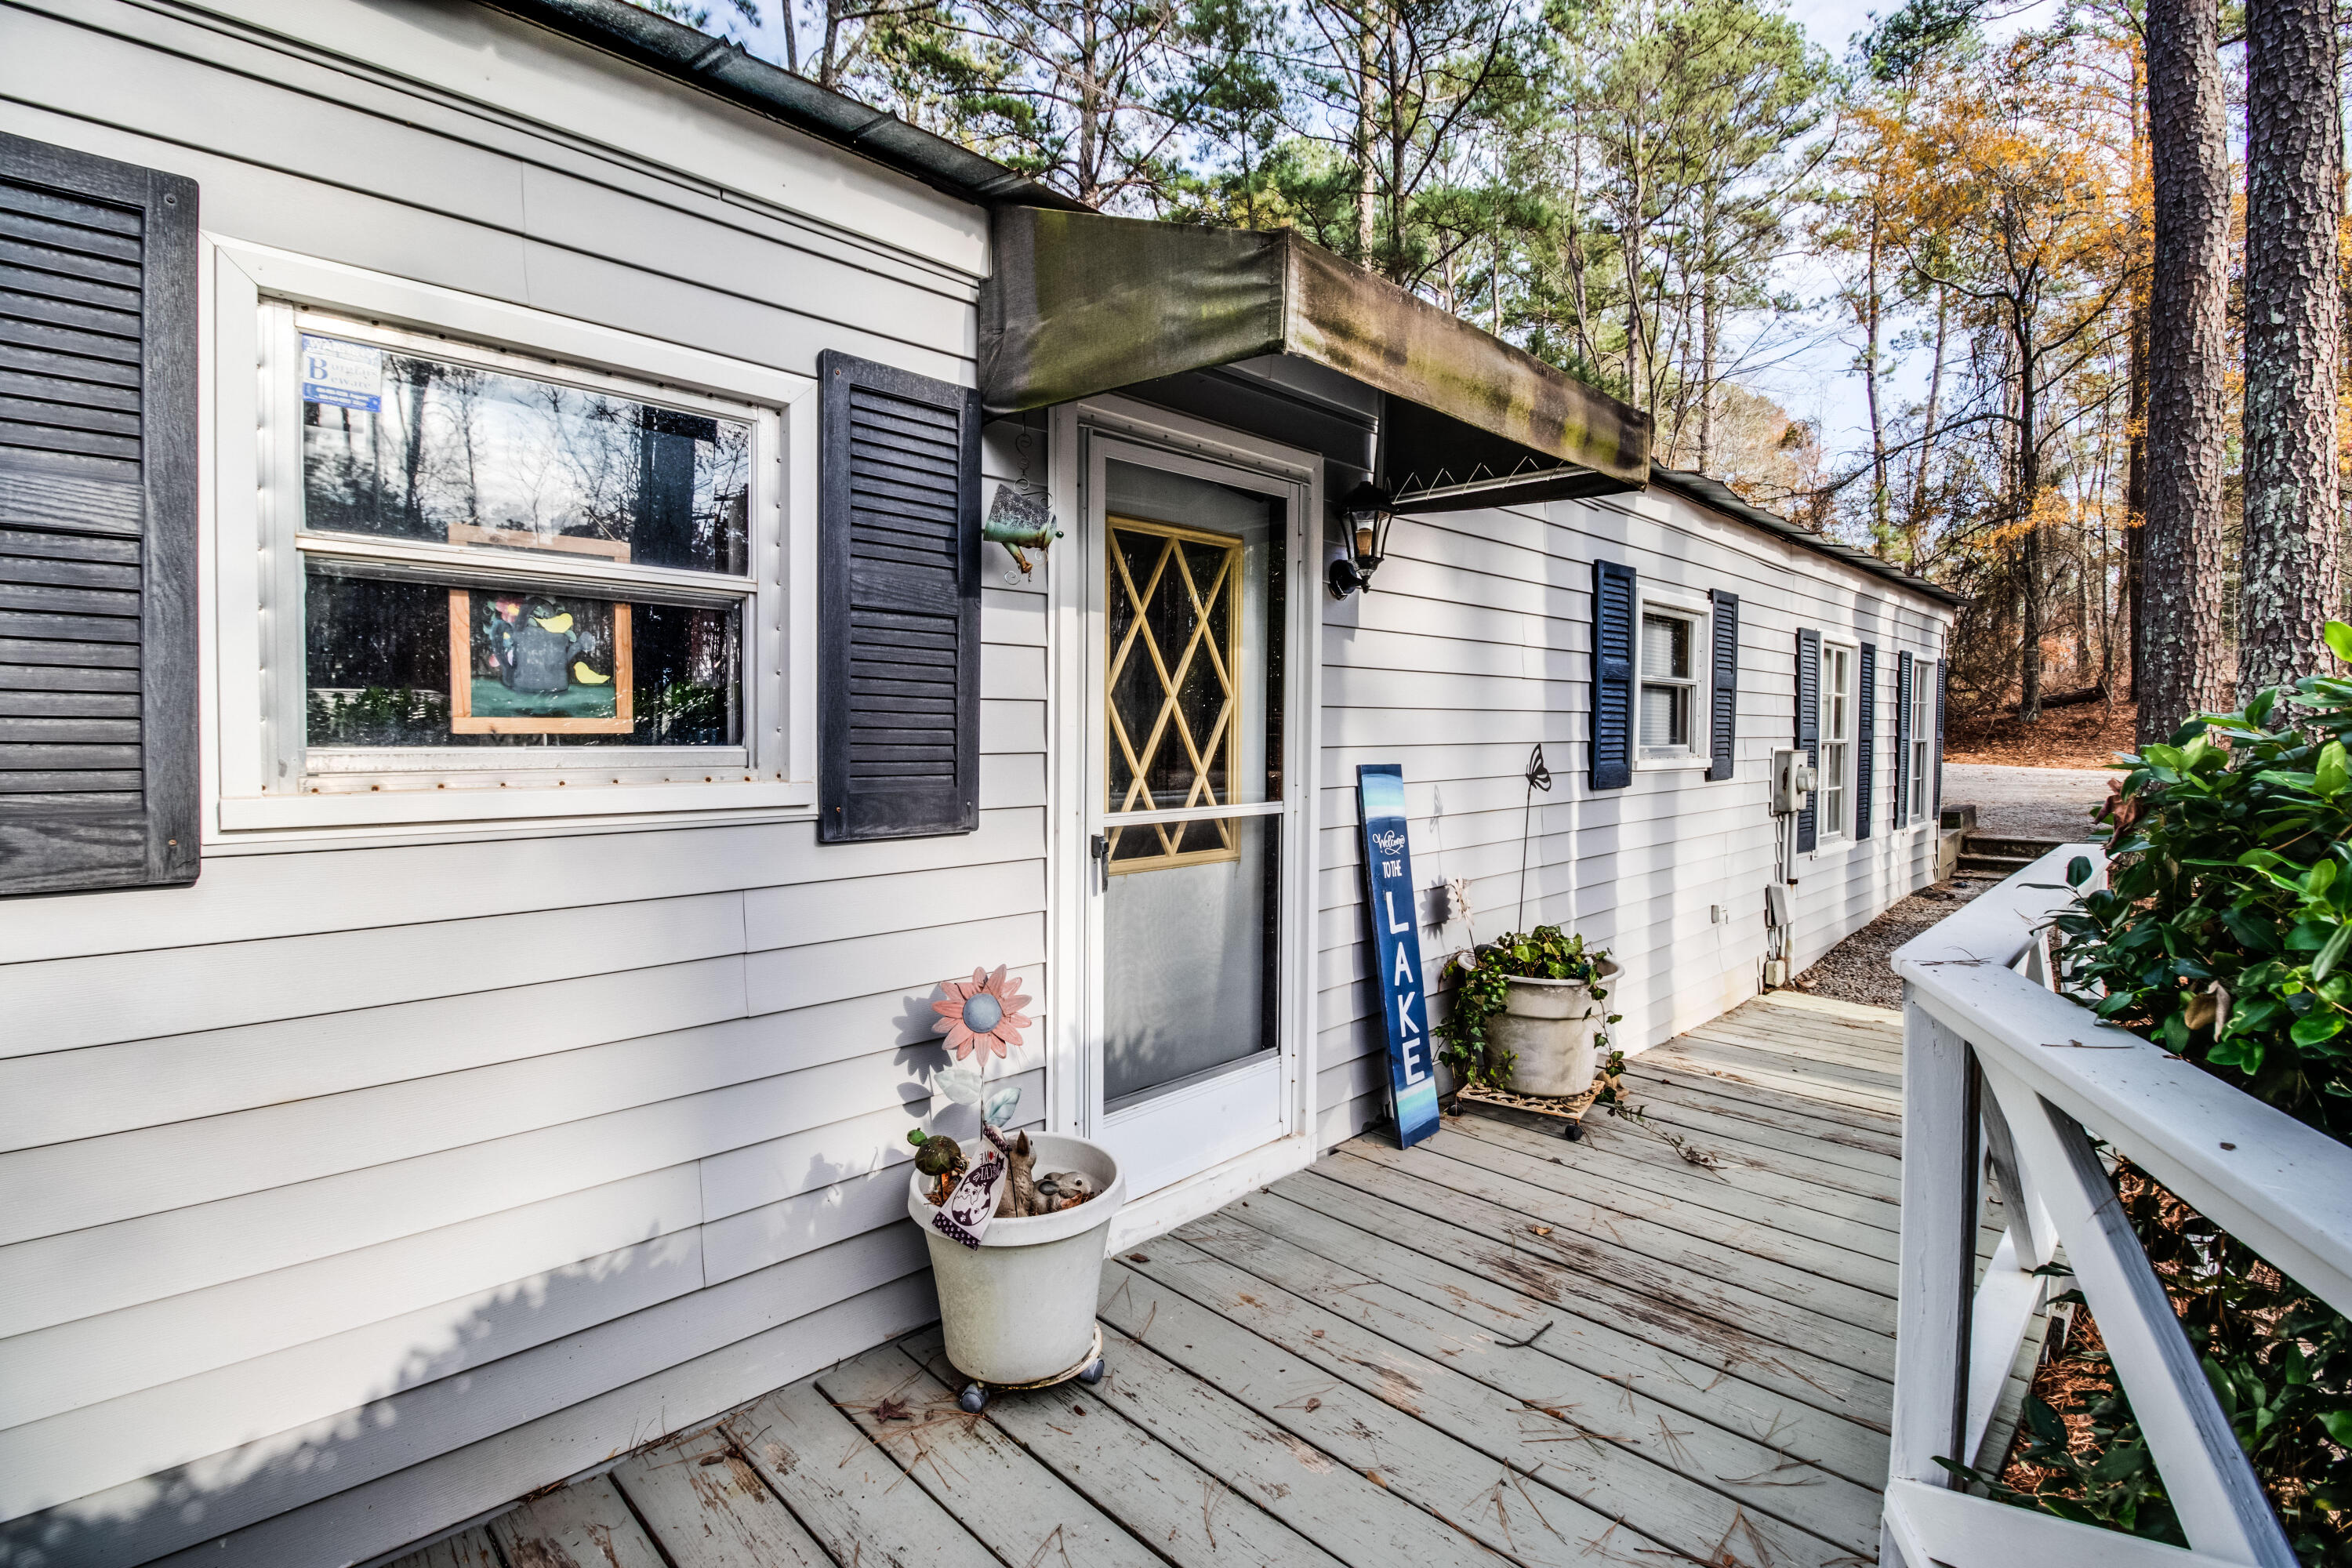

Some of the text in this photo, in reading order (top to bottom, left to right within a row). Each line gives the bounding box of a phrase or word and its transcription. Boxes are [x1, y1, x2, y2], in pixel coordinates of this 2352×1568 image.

[1373, 830, 1406, 855] Welcome
[1382, 859, 1403, 878] TO THE
[1385, 891, 1425, 1086] LAKE
